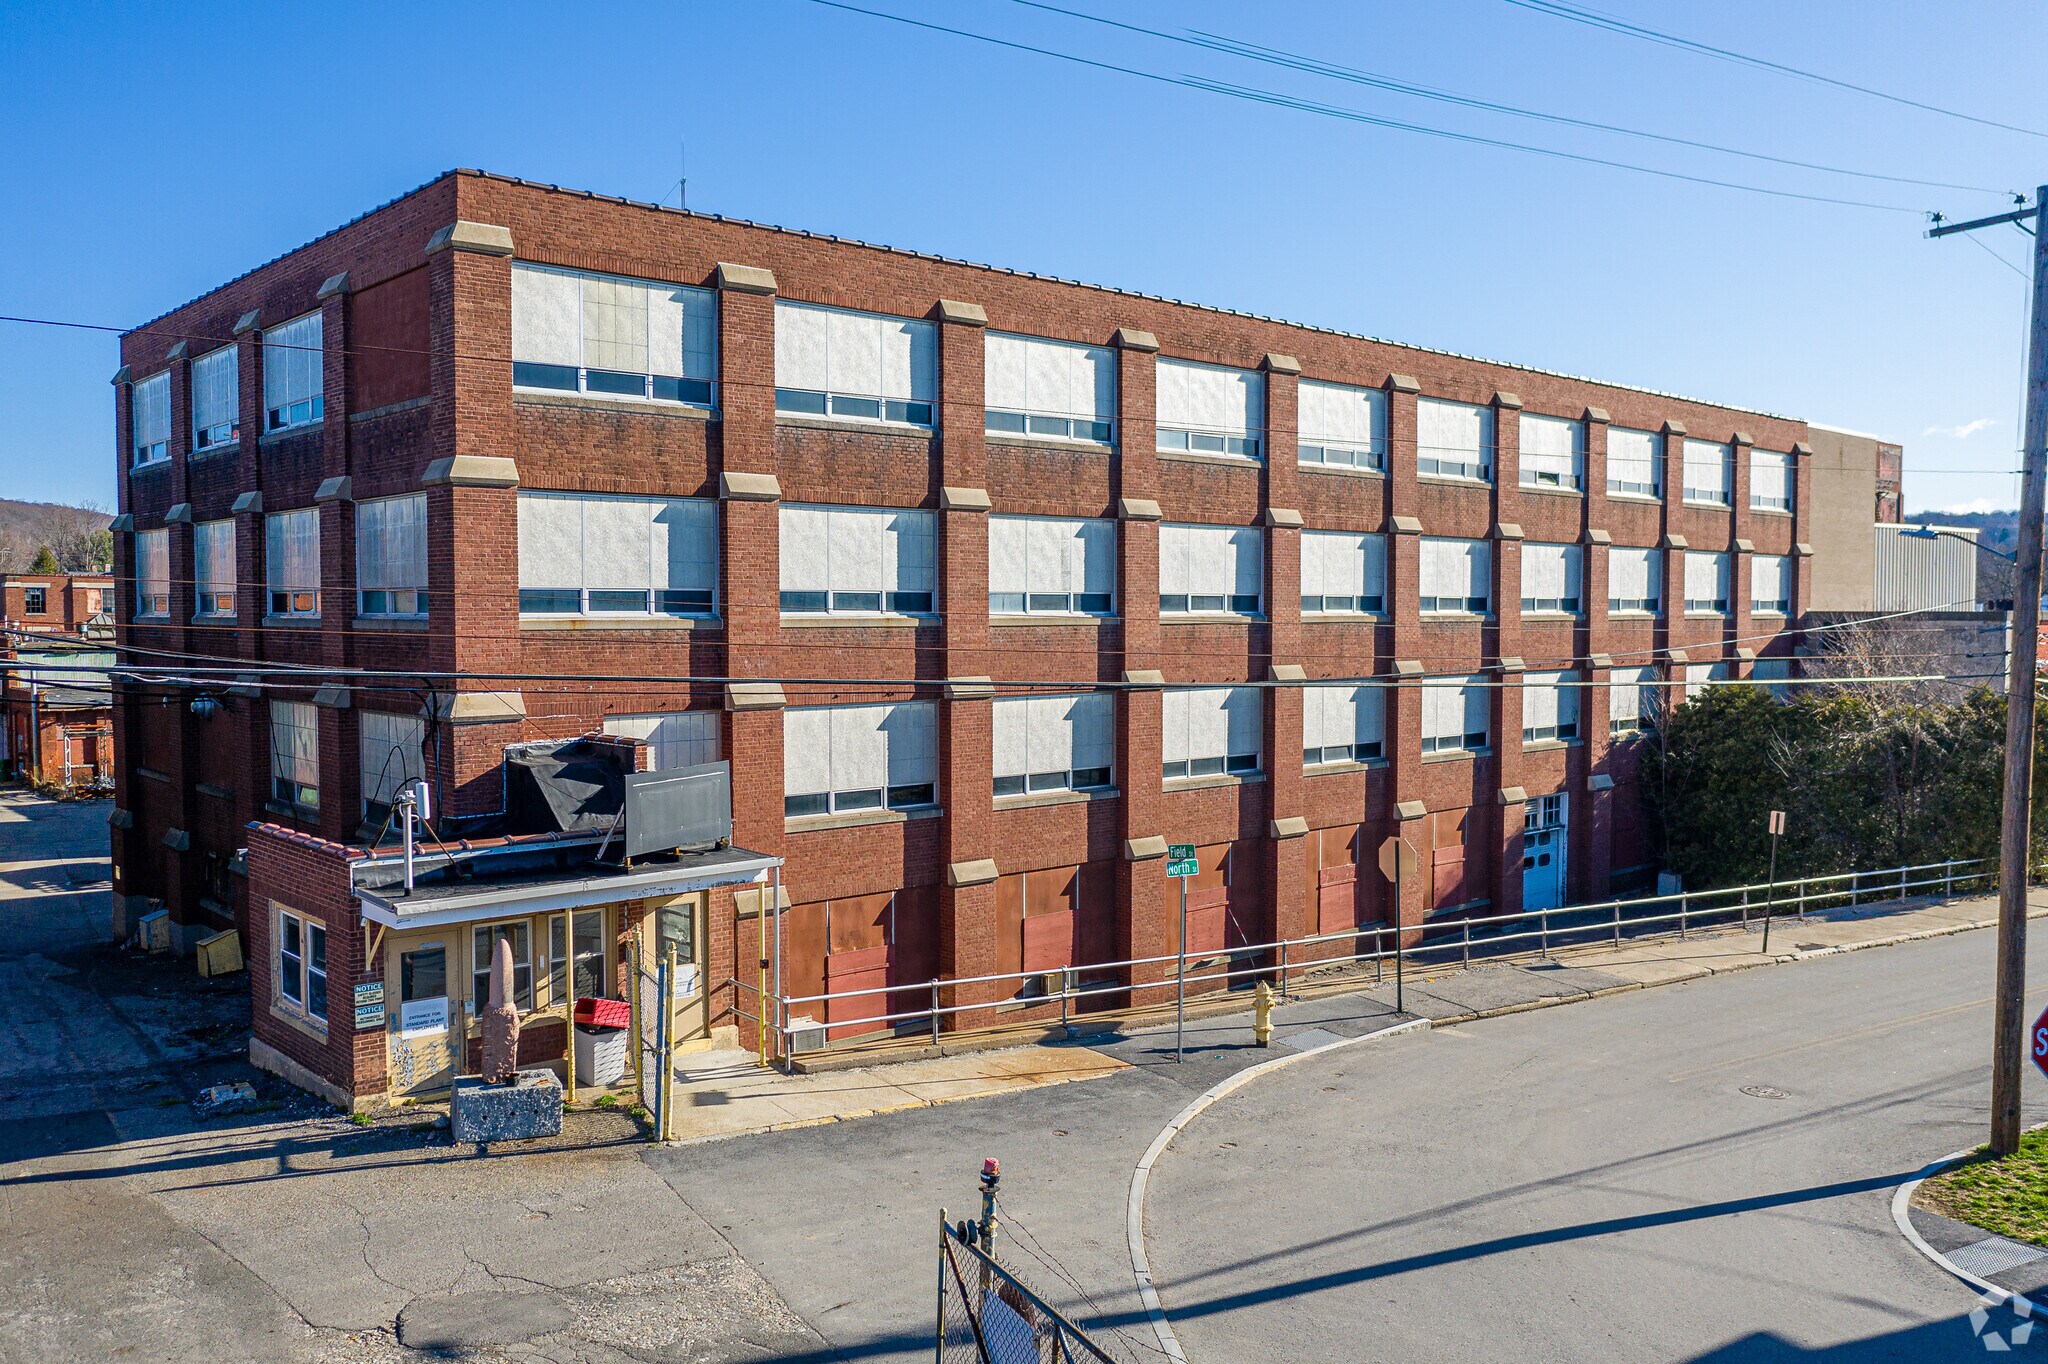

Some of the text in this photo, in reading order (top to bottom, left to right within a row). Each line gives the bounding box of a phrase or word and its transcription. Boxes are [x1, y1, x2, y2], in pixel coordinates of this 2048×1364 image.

[1170, 846, 1187, 858] Field
[1168, 863, 1190, 874] North
[356, 983, 382, 992] NOTICE
[357, 1005, 383, 1015] NOTICE
[405, 1019, 430, 1027] STANDARD
